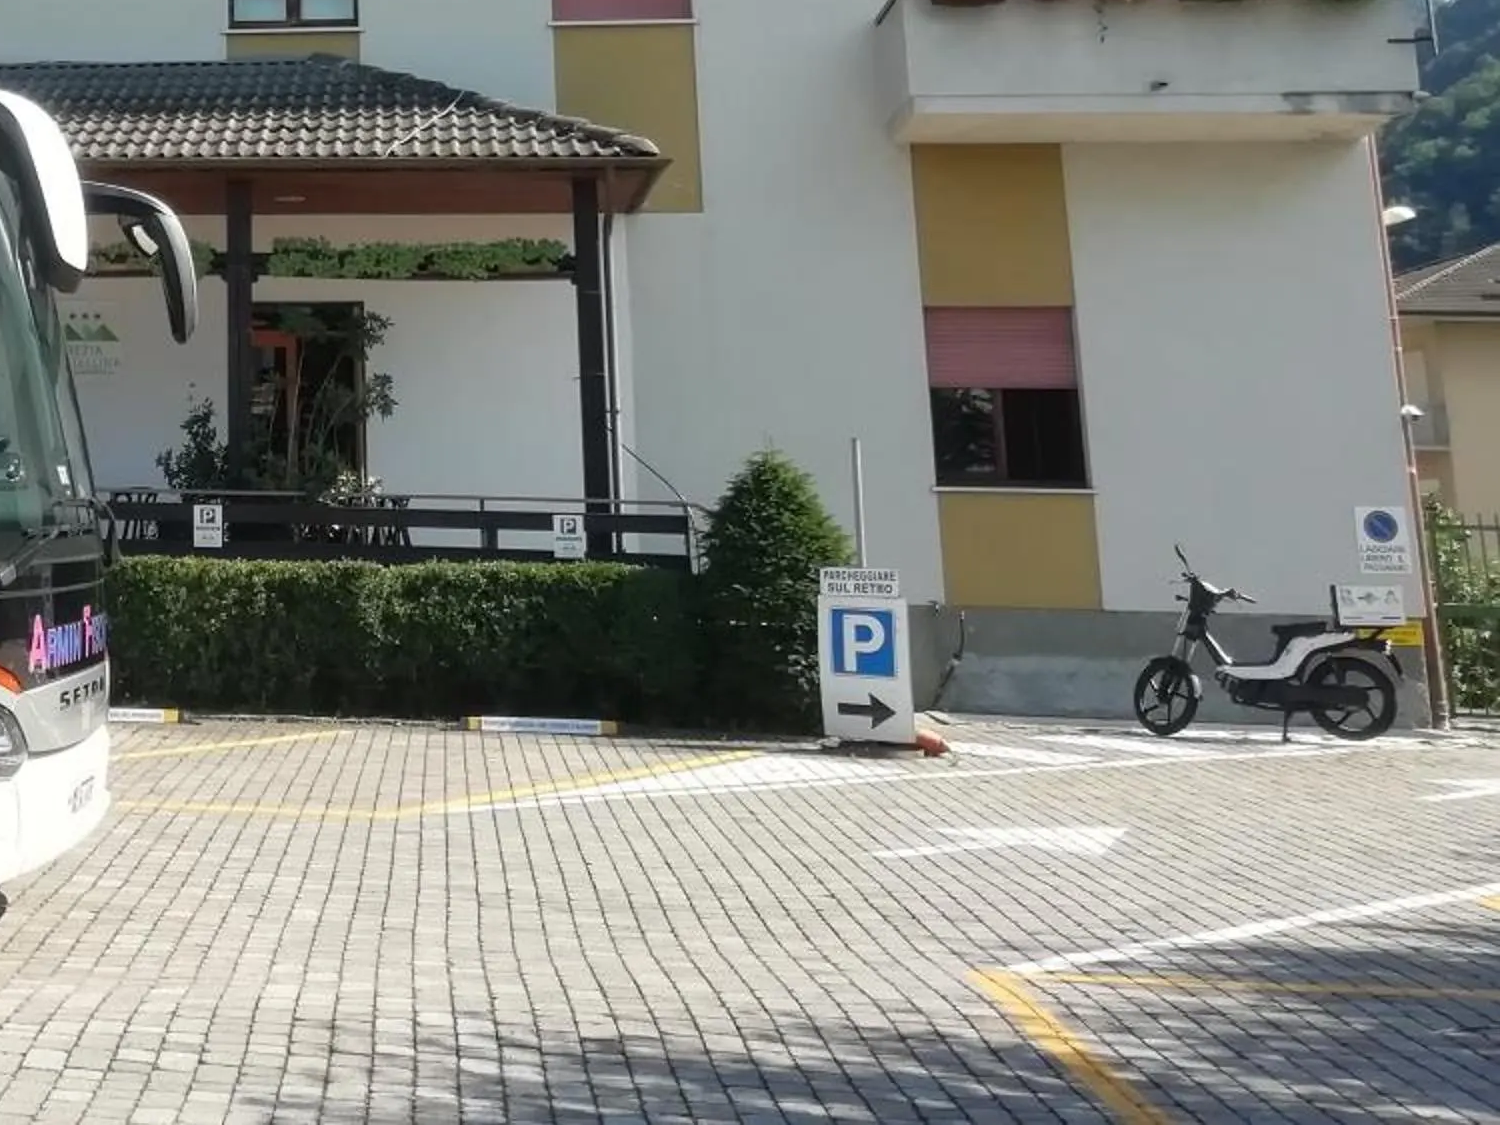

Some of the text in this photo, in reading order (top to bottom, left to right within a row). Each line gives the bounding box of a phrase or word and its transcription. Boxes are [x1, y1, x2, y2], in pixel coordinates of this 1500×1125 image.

[827, 582, 893, 594] SUL RETRO
[28, 614, 82, 674] ARMIN
[842, 613, 886, 673] P
